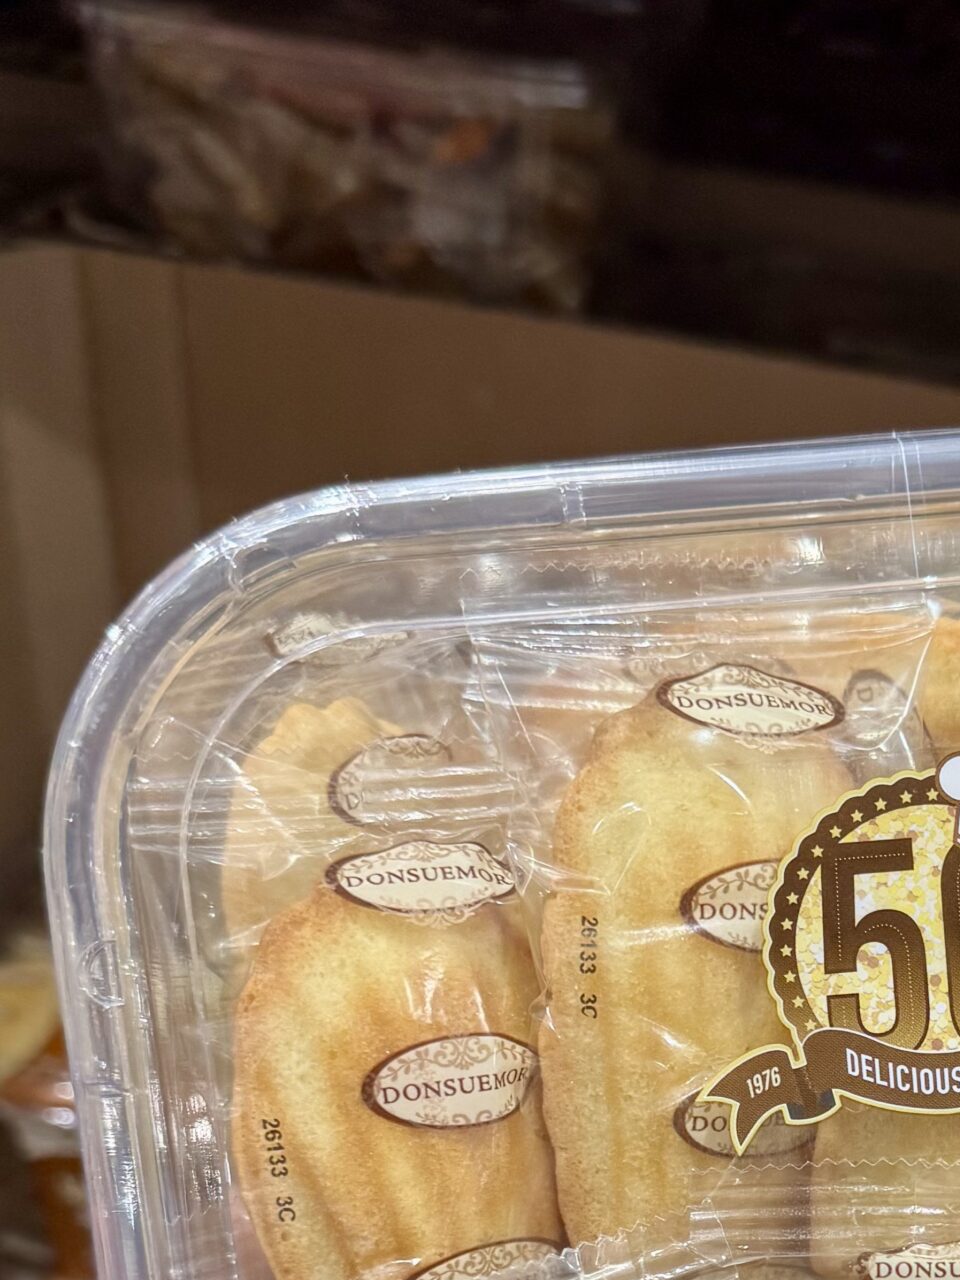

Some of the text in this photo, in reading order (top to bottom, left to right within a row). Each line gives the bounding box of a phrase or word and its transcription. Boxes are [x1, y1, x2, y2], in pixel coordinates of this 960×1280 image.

[675, 692, 834, 717] DONSUEMOR
[345, 865, 515, 888] DONSUEMOR
[579, 915, 599, 1019] 26133 3C
[745, 1066, 782, 1100] 1976
[261, 1118, 296, 1224] 26133 3C
